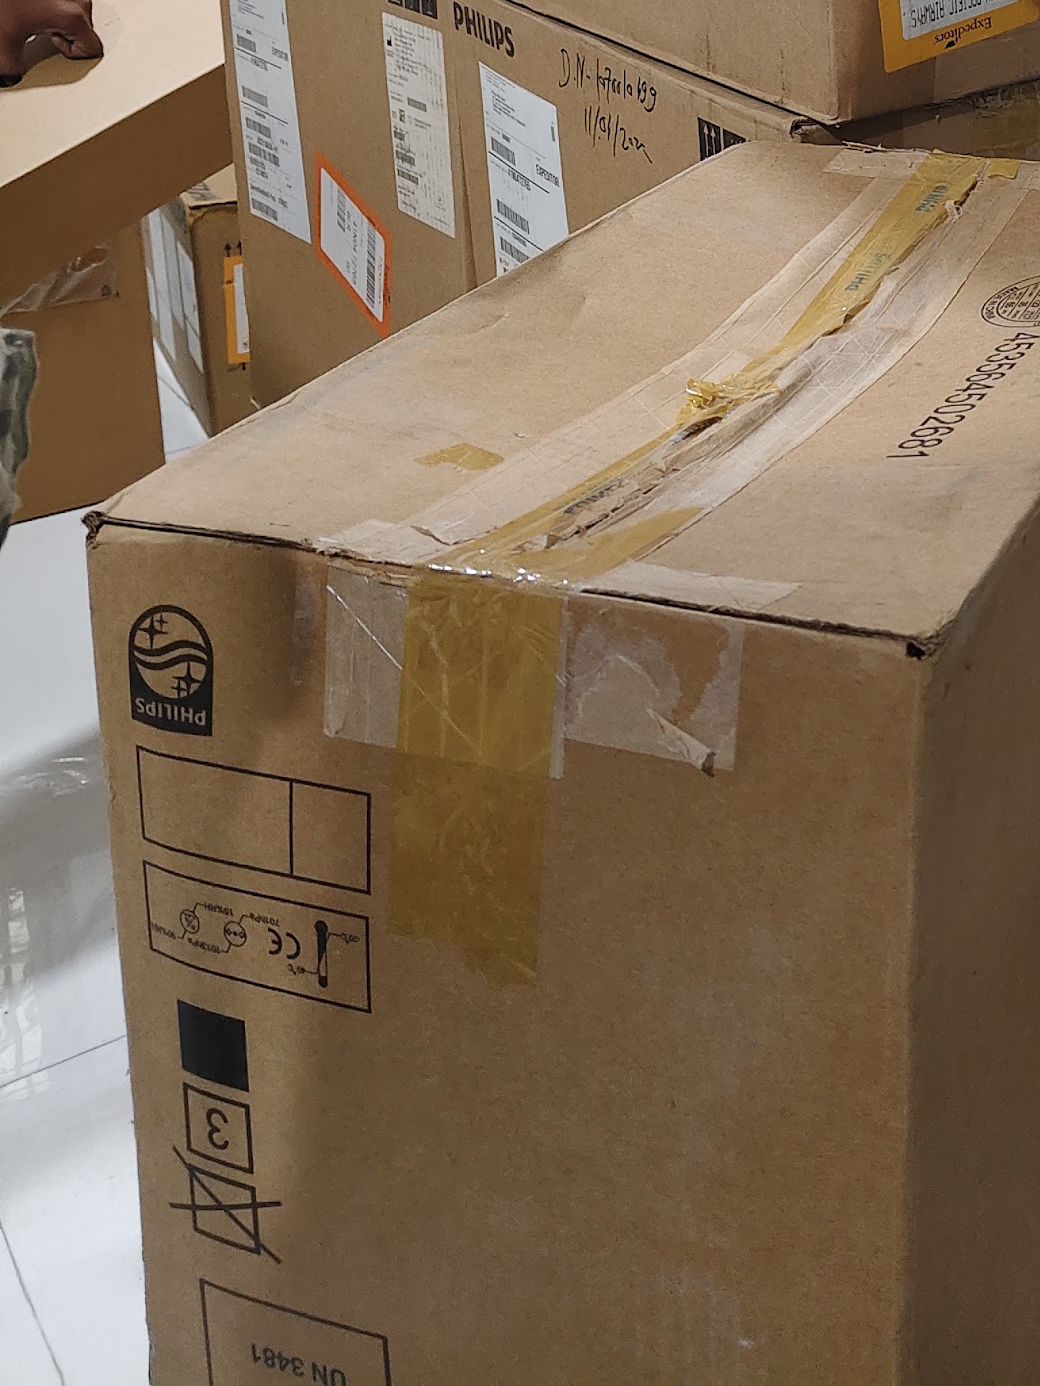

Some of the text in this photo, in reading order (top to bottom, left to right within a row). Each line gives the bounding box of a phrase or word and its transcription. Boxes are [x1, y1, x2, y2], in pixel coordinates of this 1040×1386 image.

[453, 1, 515, 58] PHILIPS
[910, 0, 945, 29] AIRWAYS
[934, 16, 992, 46] Expeditors
[886, 331, 1040, 459] 453564502681
[135, 697, 207, 727] PHILIPS
[205, 1108, 230, 1150] 3
[251, 1343, 347, 1386] UN 3481
